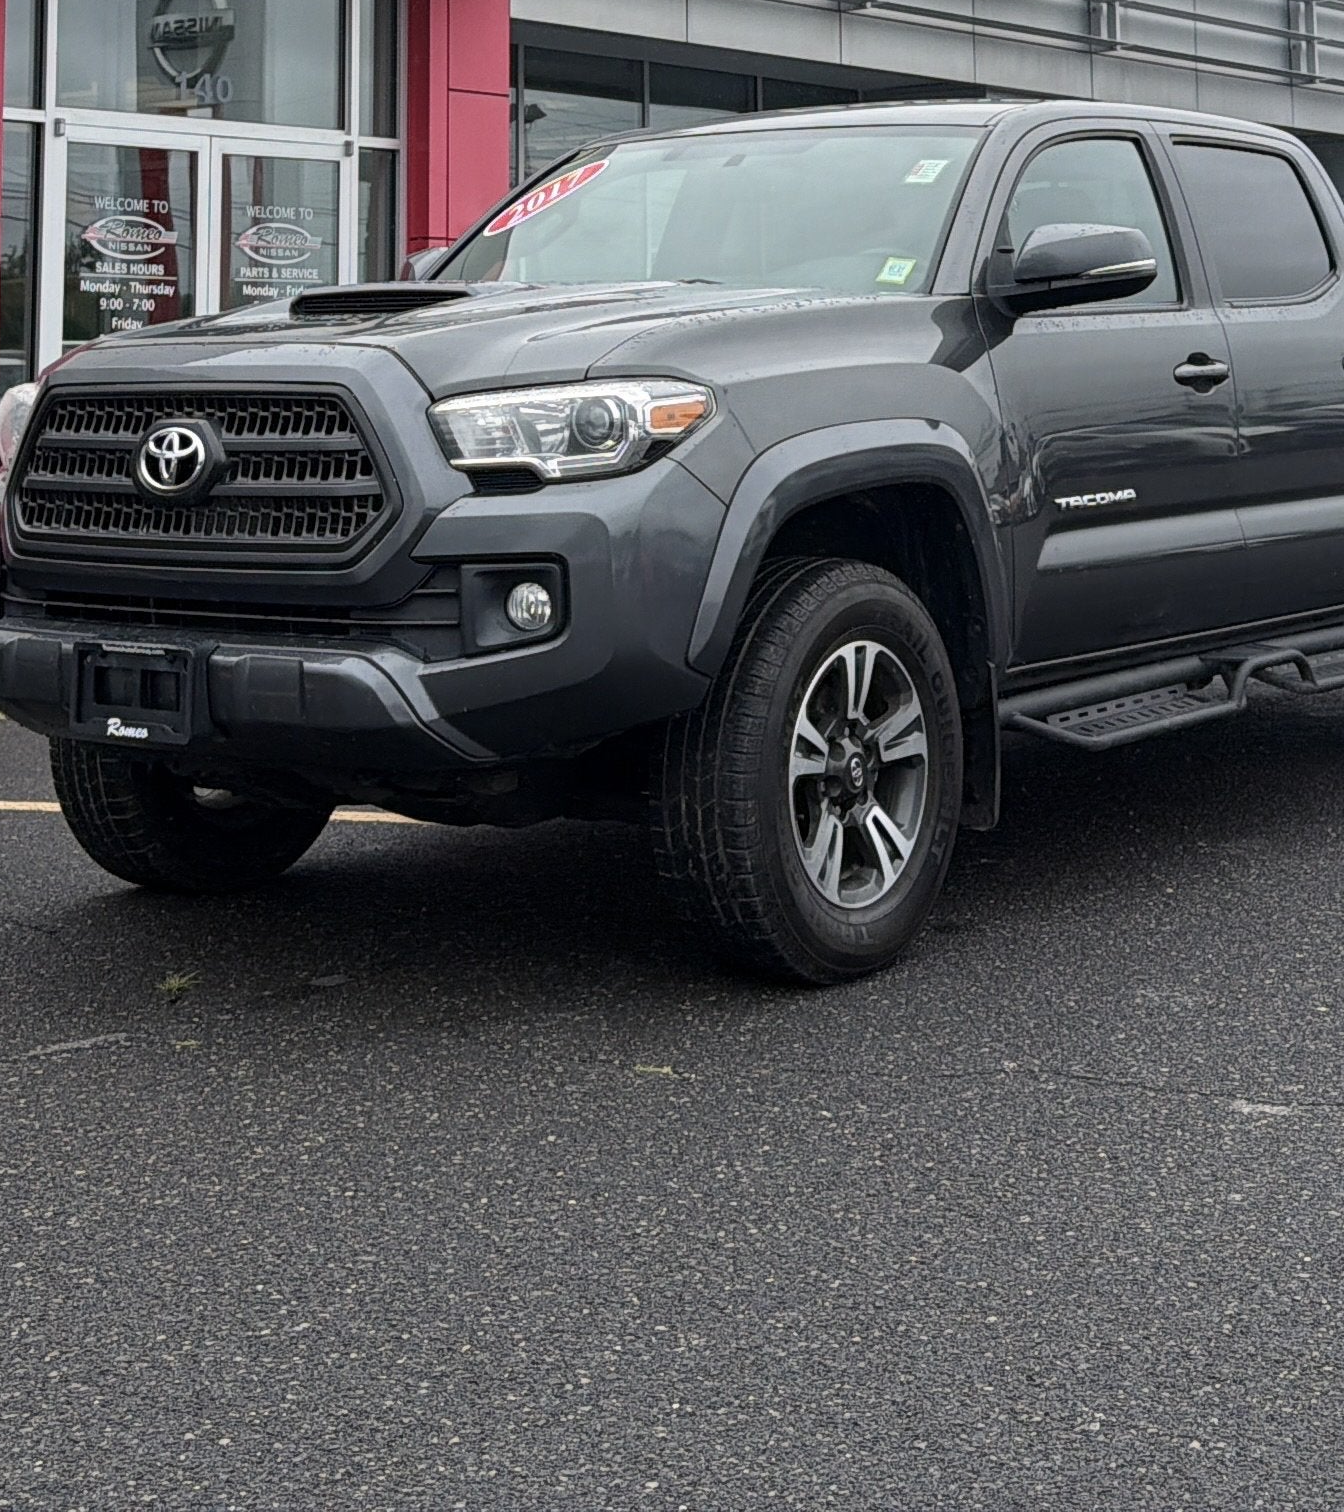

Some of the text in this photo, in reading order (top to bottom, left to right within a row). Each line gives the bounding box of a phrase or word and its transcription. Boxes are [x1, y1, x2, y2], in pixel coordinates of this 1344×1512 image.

[175, 71, 233, 103] 140
[94, 196, 169, 213] WELCOME TO
[506, 169, 586, 227] 2017
[246, 206, 314, 220] WELCOME TO
[103, 219, 163, 240] Romeo
[254, 227, 309, 247] Romeo
[108, 241, 152, 252] NISSAN
[259, 247, 299, 257] NISSAN
[96, 261, 165, 275] SALES HOURS
[240, 267, 319, 279] PARTS & SERVICE
[80, 280, 121, 294] Monday
[129, 282, 176, 296] Thursday
[242, 285, 279, 298] Monday
[99, 298, 123, 310] 9:00
[132, 299, 156, 311] 7:00
[112, 317, 143, 329] Friday
[1054, 488, 1137, 508] TACOMA
[106, 717, 149, 739] Romeo
